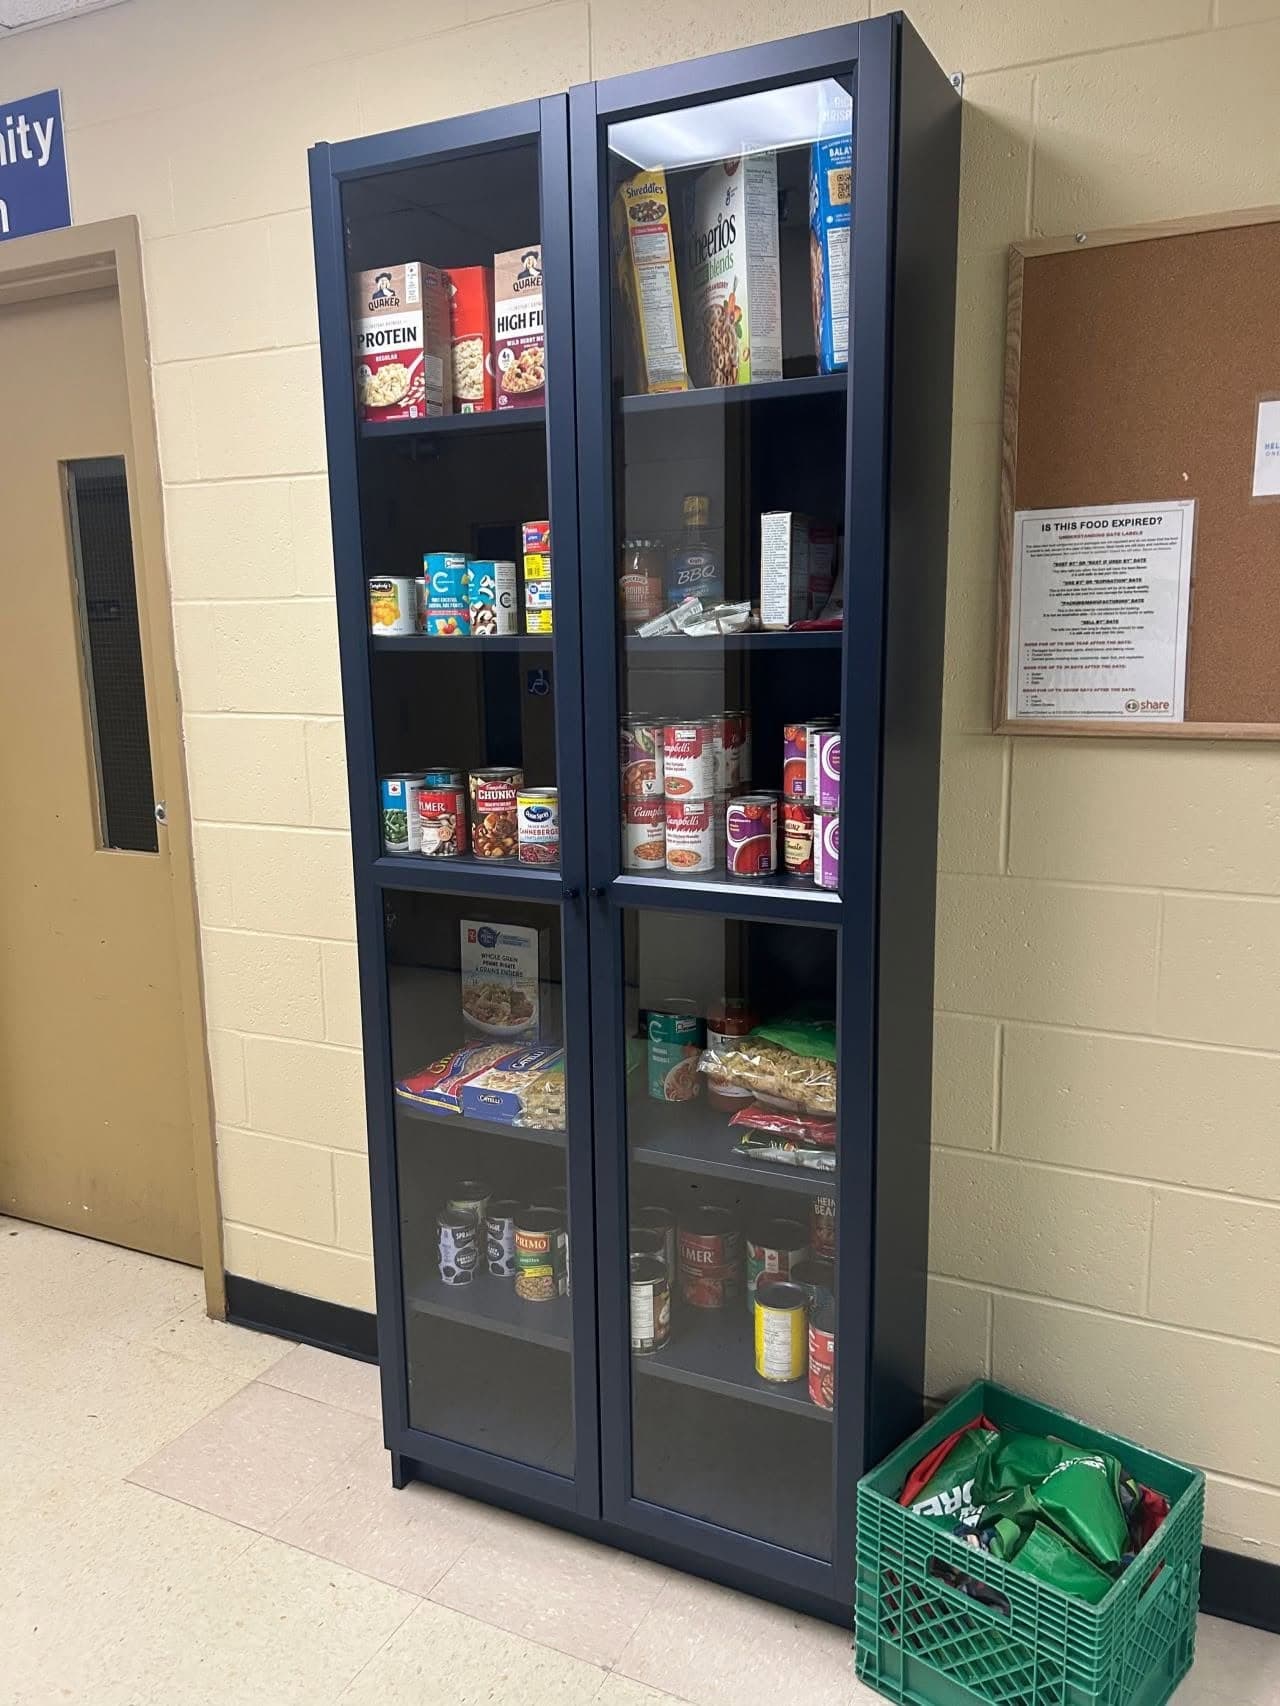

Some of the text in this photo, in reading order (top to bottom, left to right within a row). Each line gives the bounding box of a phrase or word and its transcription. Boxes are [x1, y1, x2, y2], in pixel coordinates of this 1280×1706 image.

[626, 182, 664, 199] Shreddies
[513, 276, 543, 293] QUAKE
[368, 297, 400, 311] QUAKER
[497, 313, 526, 333] HIGH
[356, 326, 417, 349] PROTEIN
[1041, 517, 1162, 533] IS THIS FOOD EXPIRED?
[677, 564, 717, 585] BBQ
[1140, 700, 1170, 710] share
[478, 789, 517, 800] CHUNKY
[667, 816, 699, 829] Campbell's
[515, 1232, 547, 1249] PRIMO
